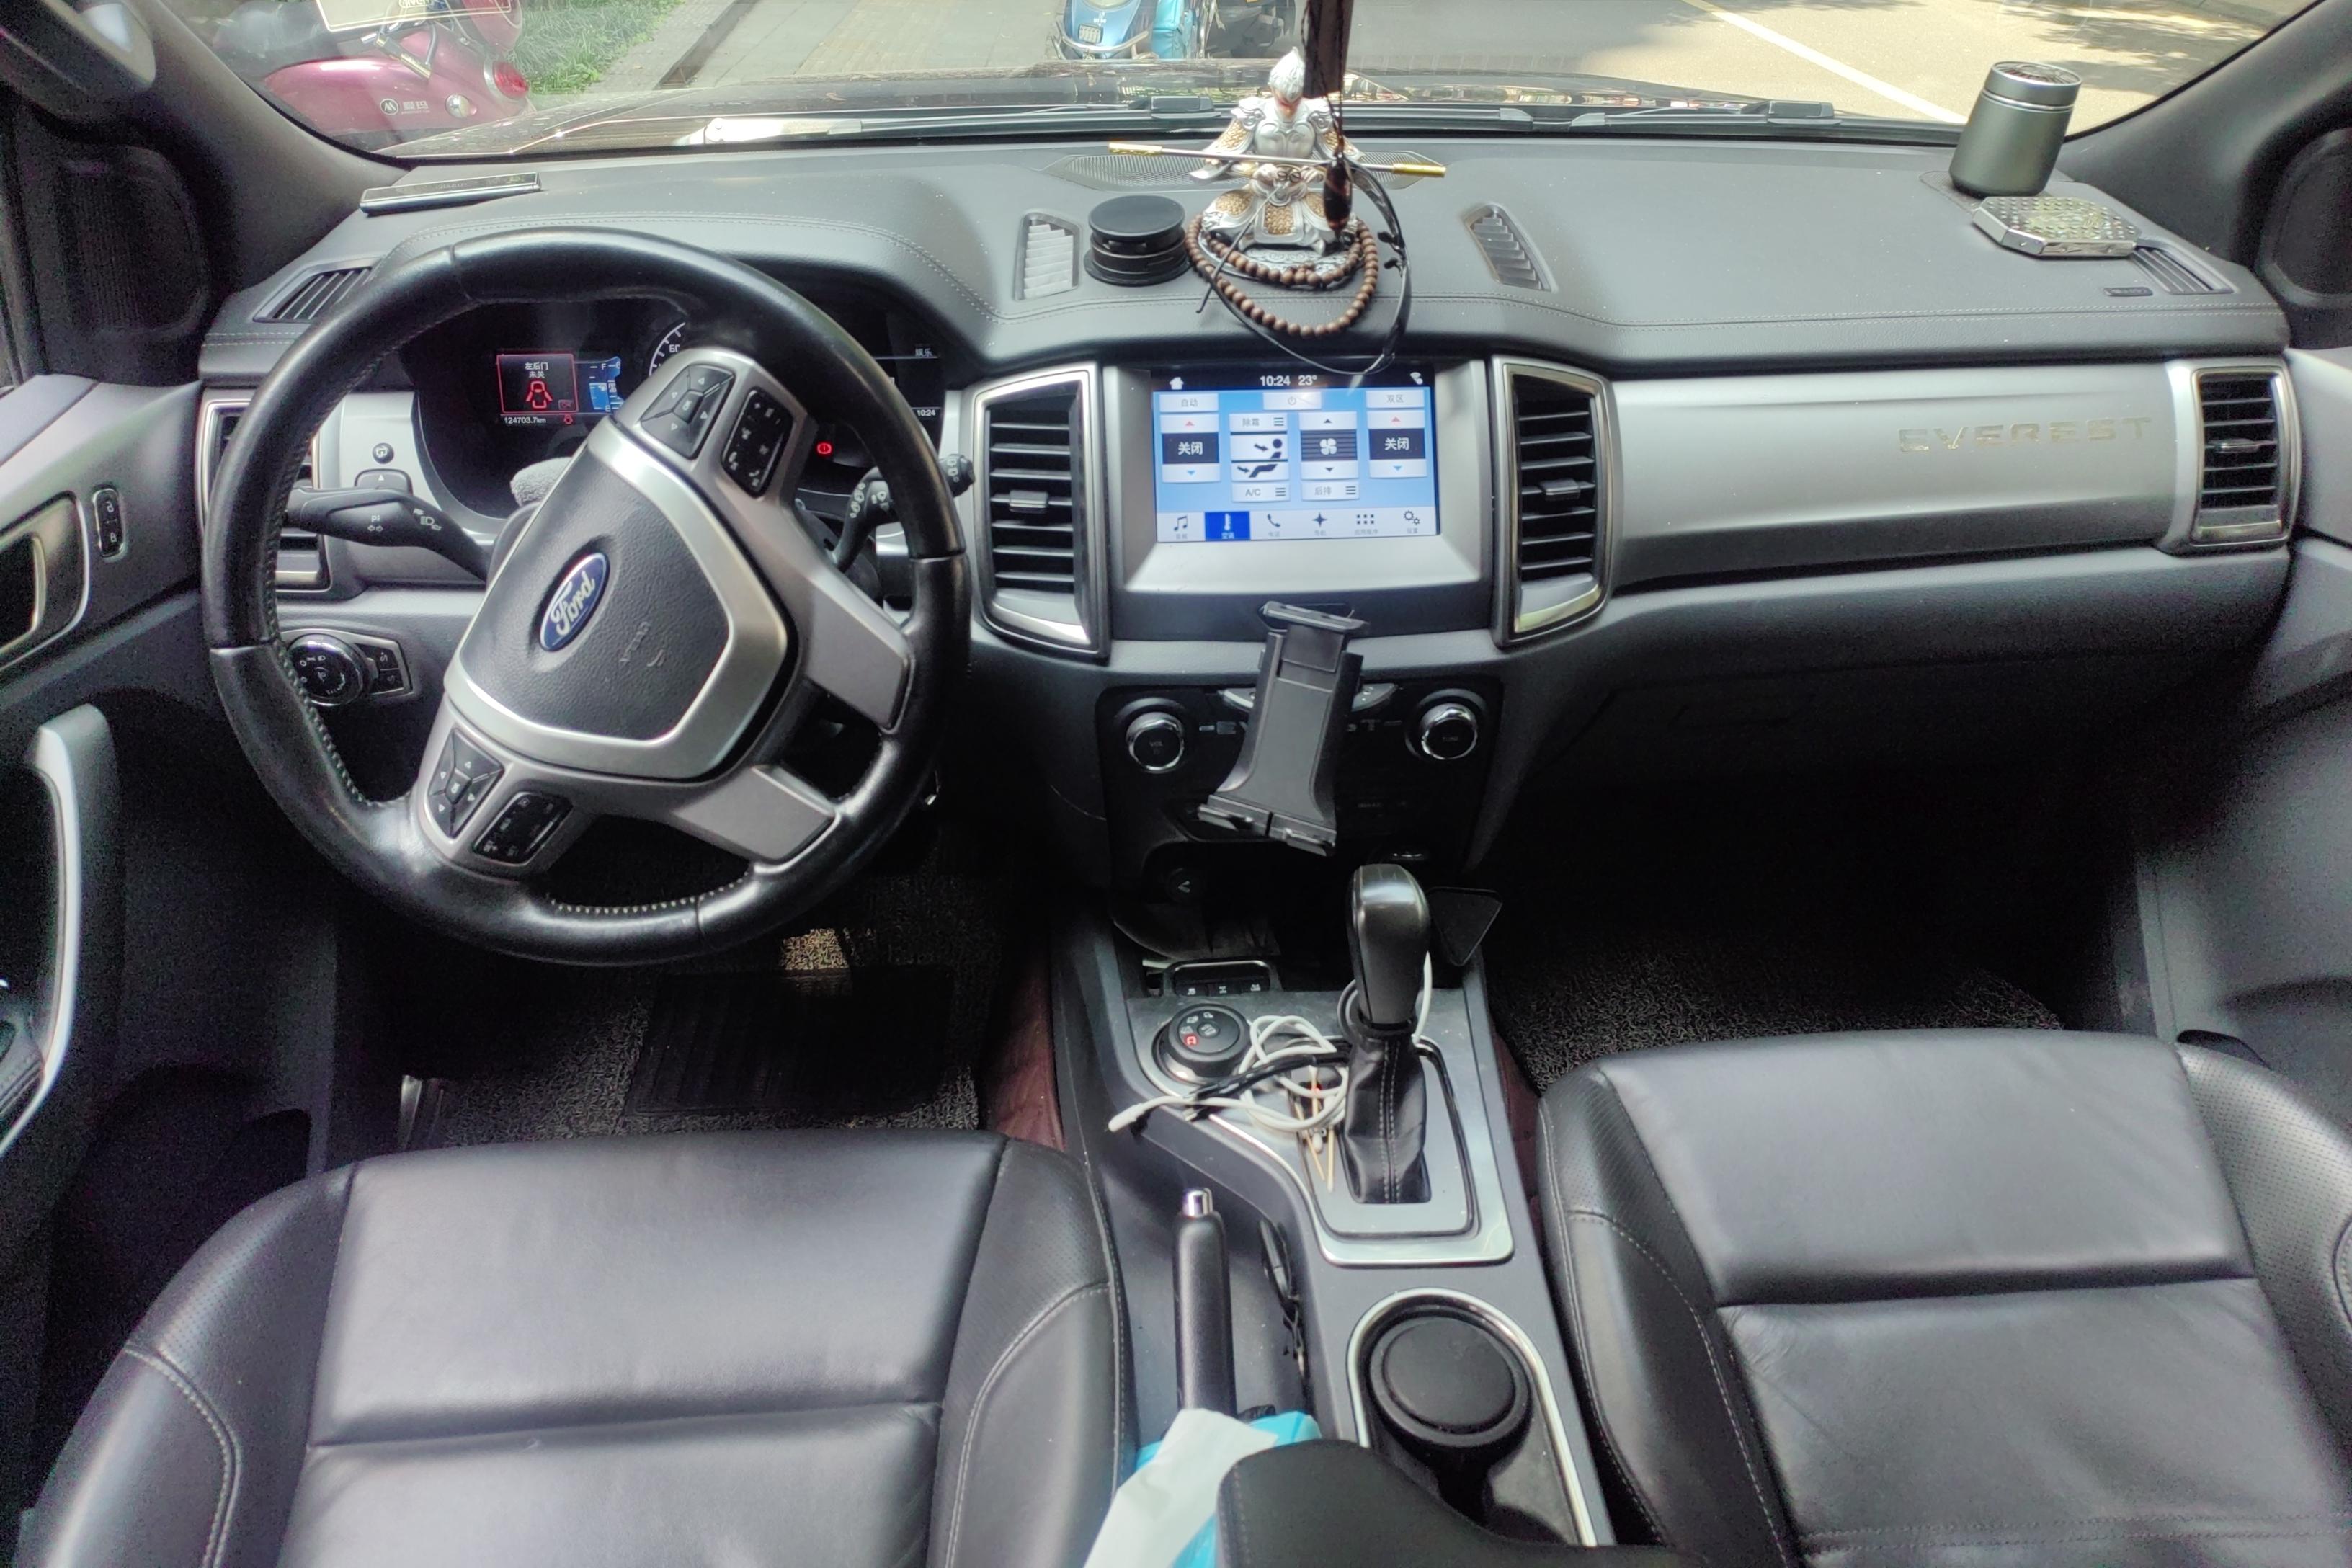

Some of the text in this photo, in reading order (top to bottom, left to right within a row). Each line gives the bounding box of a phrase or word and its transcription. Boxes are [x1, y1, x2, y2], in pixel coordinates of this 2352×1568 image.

[915, 347, 933, 357] 娱乐
[525, 362, 549, 370] 左后门
[1260, 374, 1318, 386] 10:24 23°
[1180, 398, 1199, 408] 自动
[1386, 394, 1404, 404] 双区
[1242, 417, 1260, 427] 除霜
[1898, 416, 2152, 453] EVEREST
[1178, 441, 1204, 455] 关闭
[1384, 437, 1410, 451] 关闭
[1244, 487, 1262, 497] A/C
[1314, 486, 1332, 496] 后排
[550, 570, 596, 636] Ford
